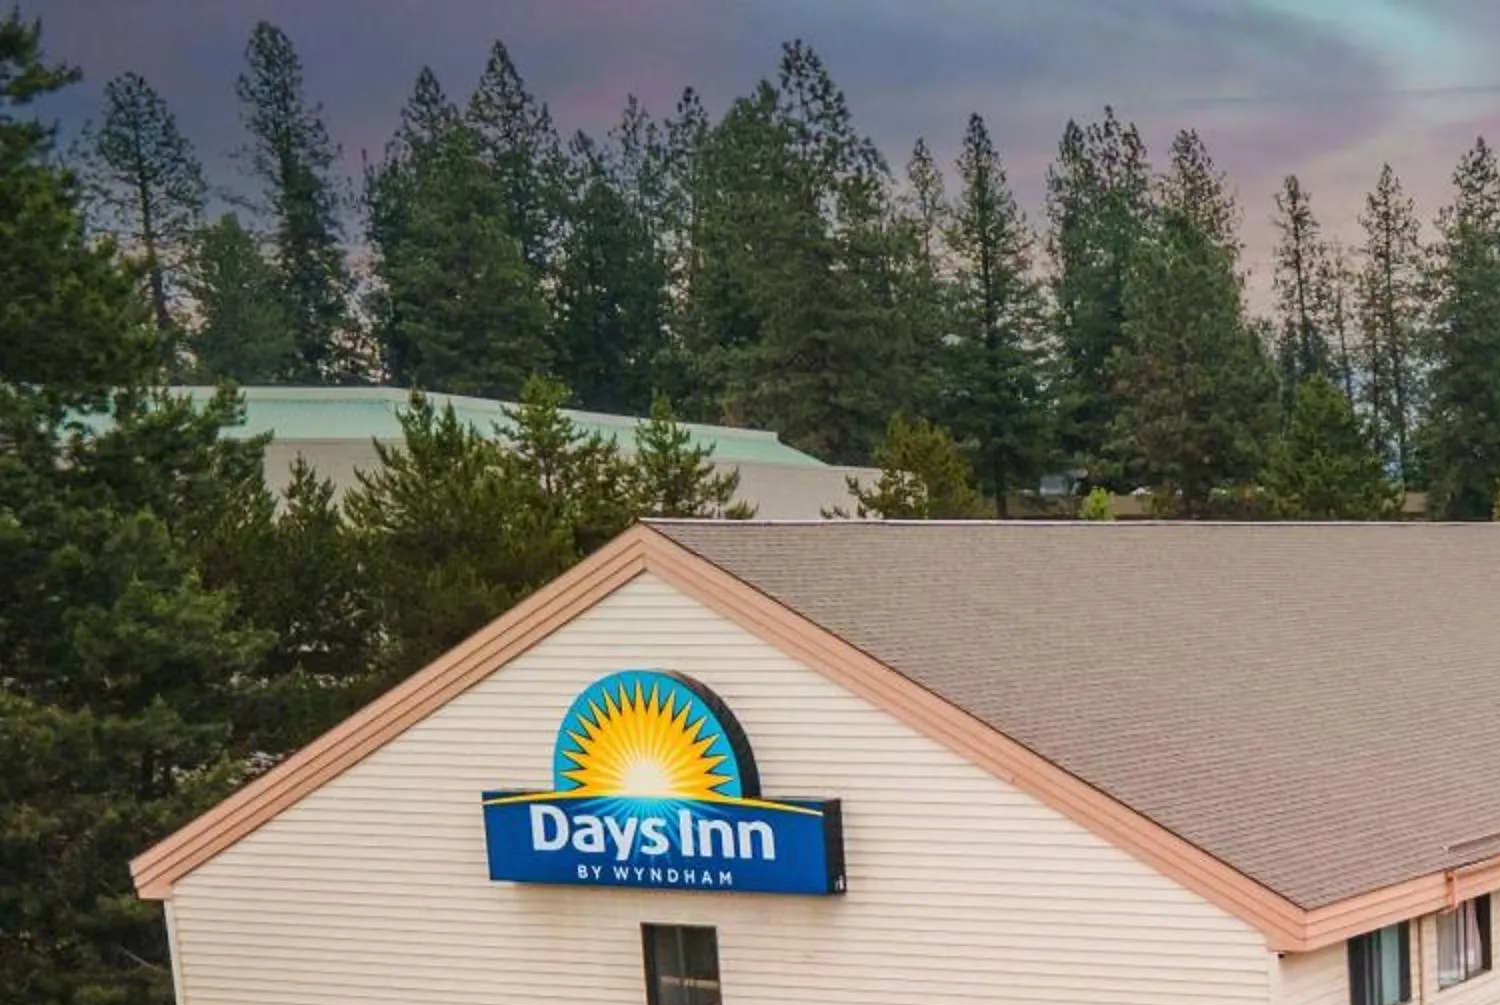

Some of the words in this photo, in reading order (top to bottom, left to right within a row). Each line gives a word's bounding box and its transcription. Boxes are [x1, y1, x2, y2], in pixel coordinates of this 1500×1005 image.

[529, 804, 669, 861] Days
[678, 809, 775, 860] Inn
[577, 865, 601, 879] BY
[614, 866, 733, 885] WYNDHAM
